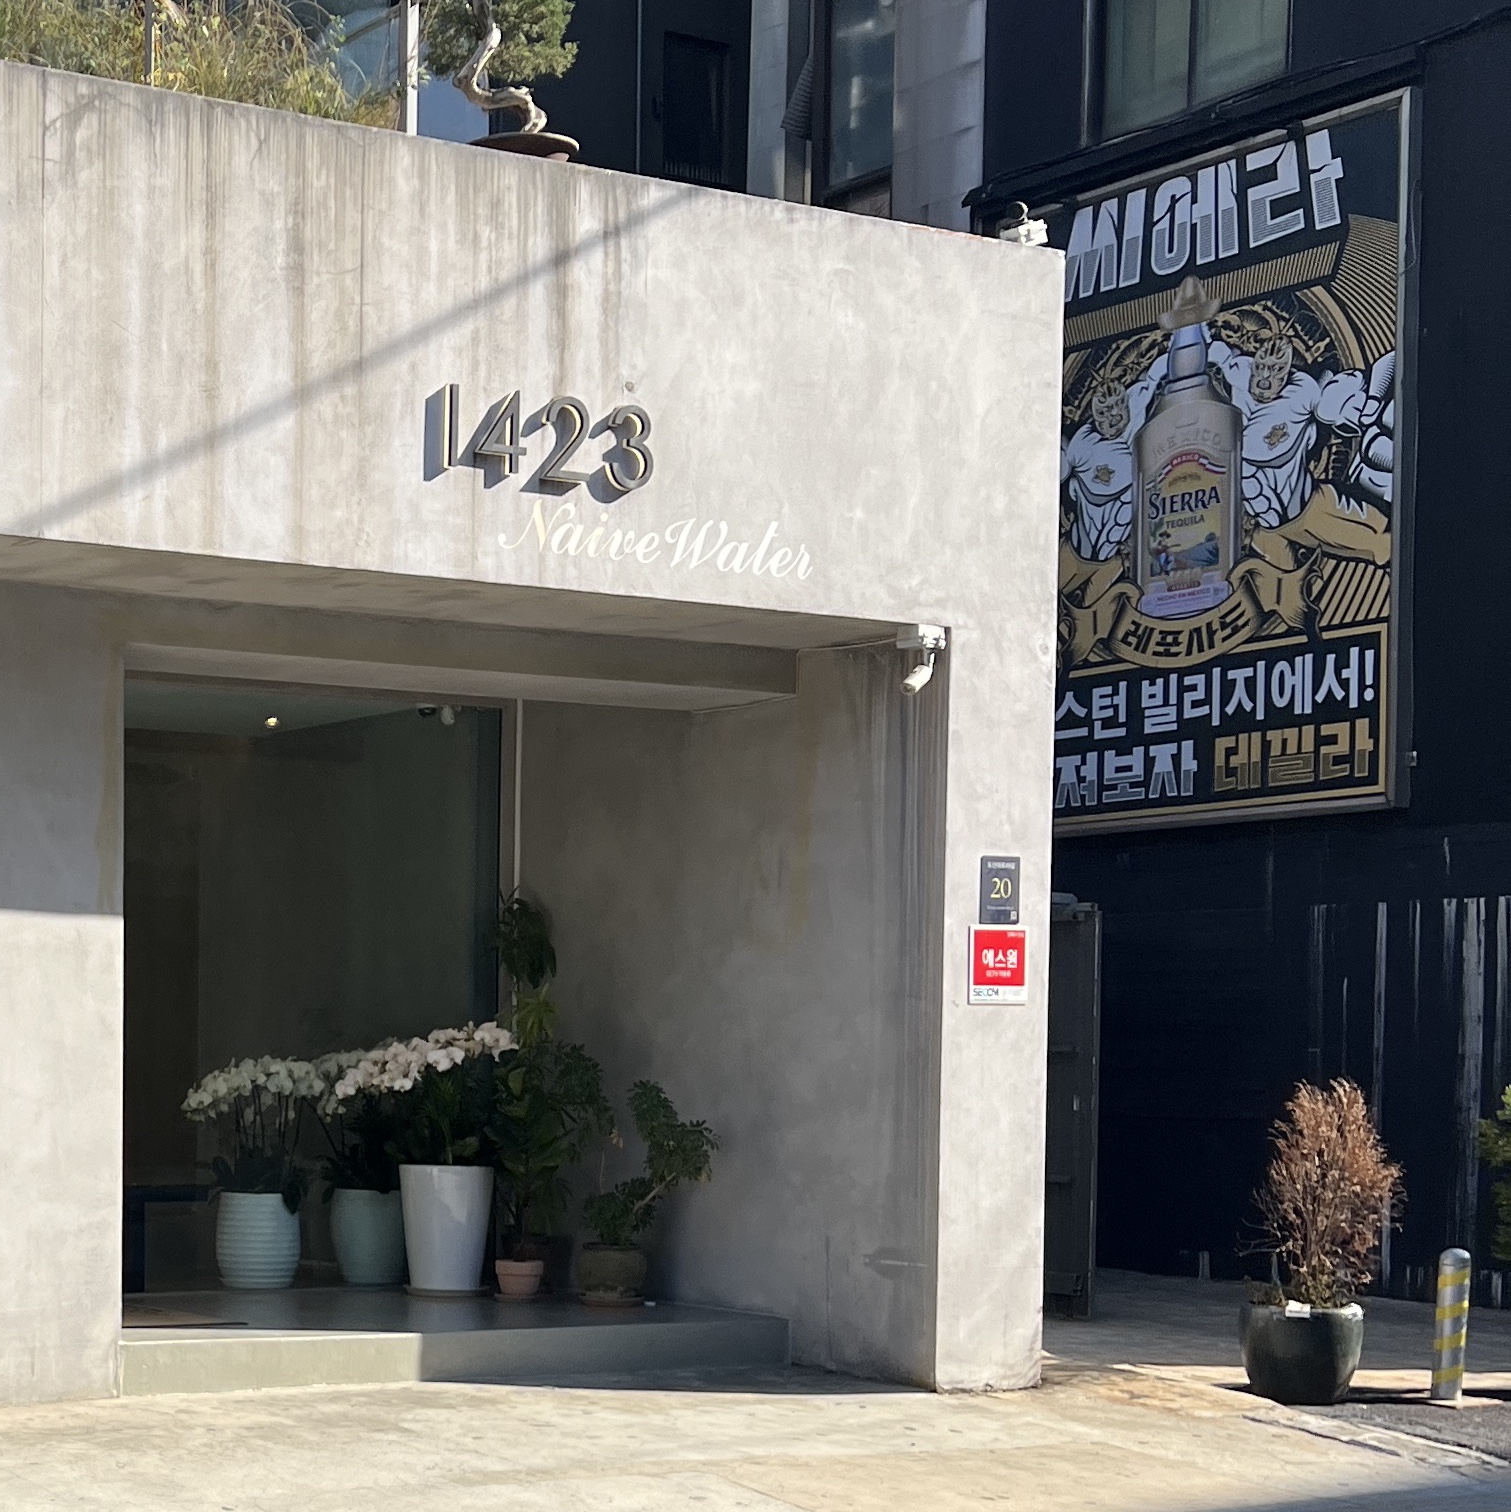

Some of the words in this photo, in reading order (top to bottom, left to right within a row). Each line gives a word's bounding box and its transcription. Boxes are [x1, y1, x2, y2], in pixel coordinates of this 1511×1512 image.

[1065, 128, 1344, 303] 씨에라
[443, 382, 655, 492] 1423
[1148, 485, 1221, 521] SIERRA
[1165, 514, 1206, 530] TEQUILA
[1119, 601, 1251, 659] 레포사도
[1141, 646, 1375, 735] 빌리지에서!
[1214, 717, 1374, 793] 데낄라
[990, 877, 1012, 899] 20
[981, 948, 1018, 969] 에스원
